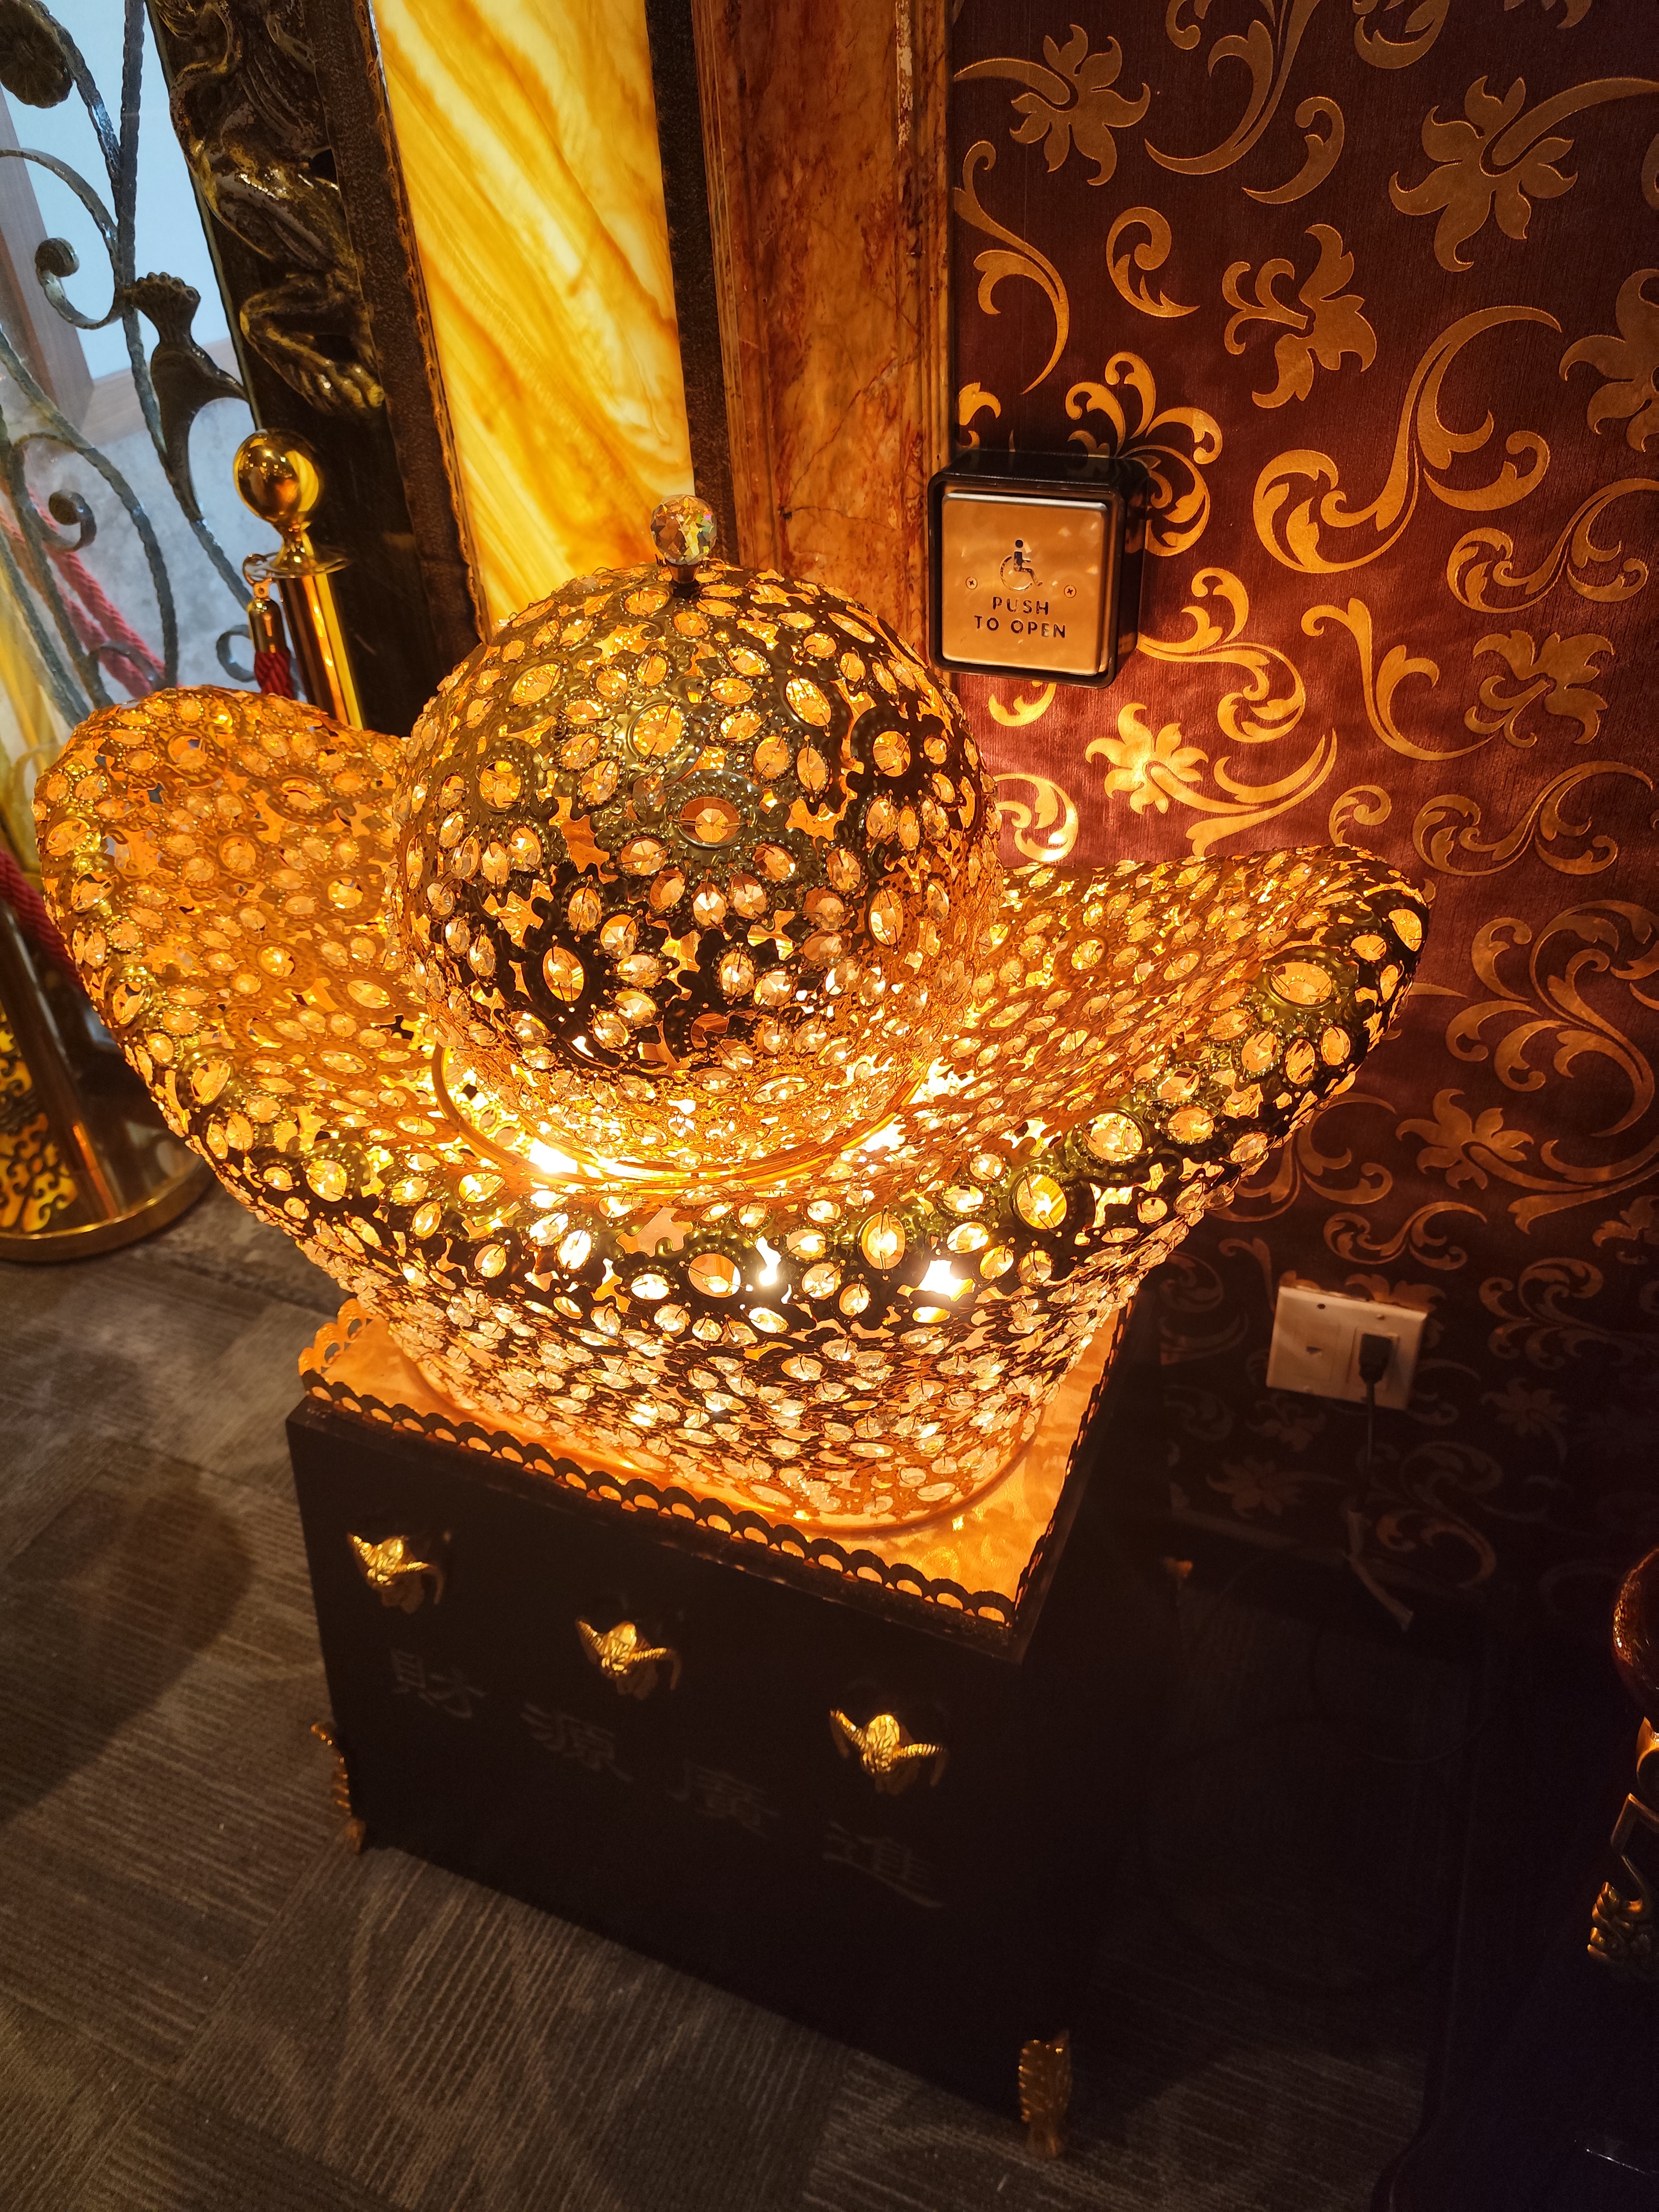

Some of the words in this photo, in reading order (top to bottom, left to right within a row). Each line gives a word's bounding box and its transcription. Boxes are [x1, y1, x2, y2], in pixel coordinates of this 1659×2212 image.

[992, 596, 1049, 615] PUSH
[974, 615, 999, 631] TO
[1011, 620, 1066, 639] OPEN
[390, 1648, 944, 1908] 財源廣進
